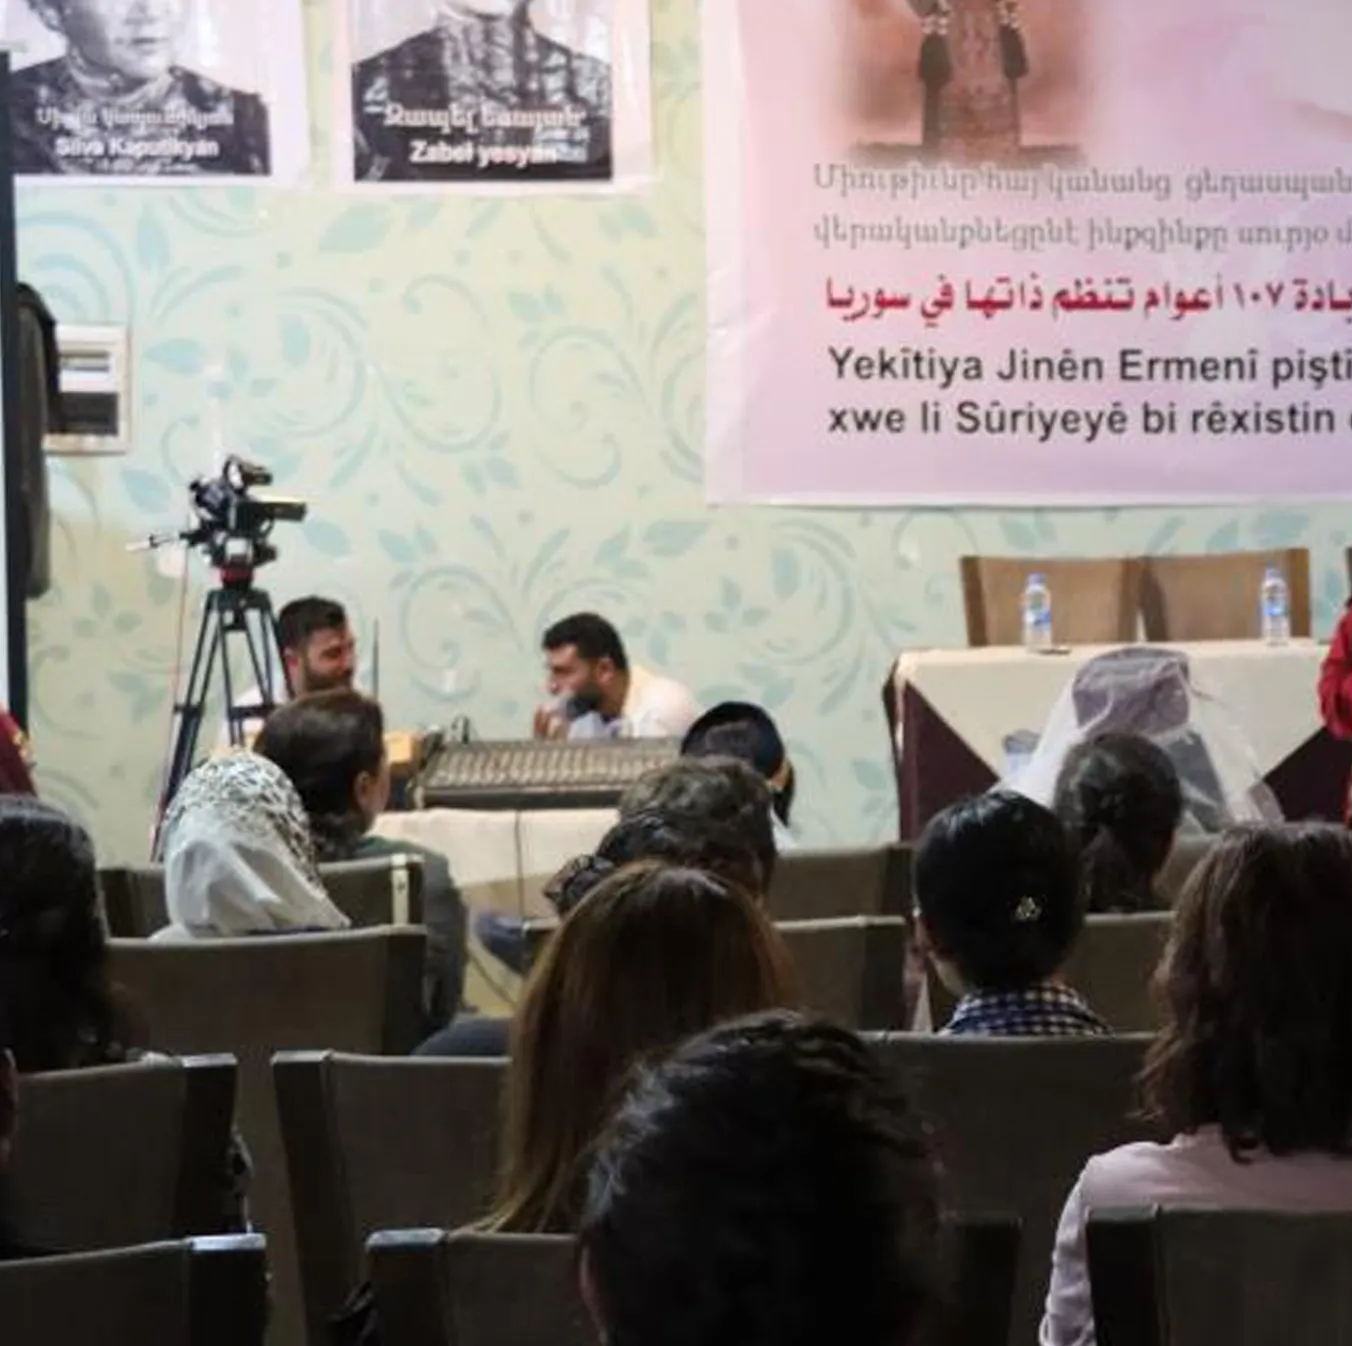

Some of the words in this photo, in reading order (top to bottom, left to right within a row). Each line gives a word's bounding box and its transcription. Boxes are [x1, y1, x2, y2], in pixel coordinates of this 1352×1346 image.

[409, 139, 473, 163] Zabel
[826, 276, 912, 322] سوريا
[920, 273, 955, 328] في
[965, 271, 1044, 320] ذاتها
[1052, 277, 1135, 321] تنظم
[1143, 273, 1224, 321] أعوام
[1233, 282, 1285, 308] ١٠٧
[828, 345, 983, 389] Yekîtiya
[997, 347, 1104, 382] Jinên
[1119, 347, 1259, 382] Ermenî
[829, 408, 905, 434] xwe
[920, 401, 941, 434] li
[957, 400, 1128, 443] Sûriyeyê
[1143, 401, 1175, 435] bi
[1191, 400, 1335, 435] rêxistin
